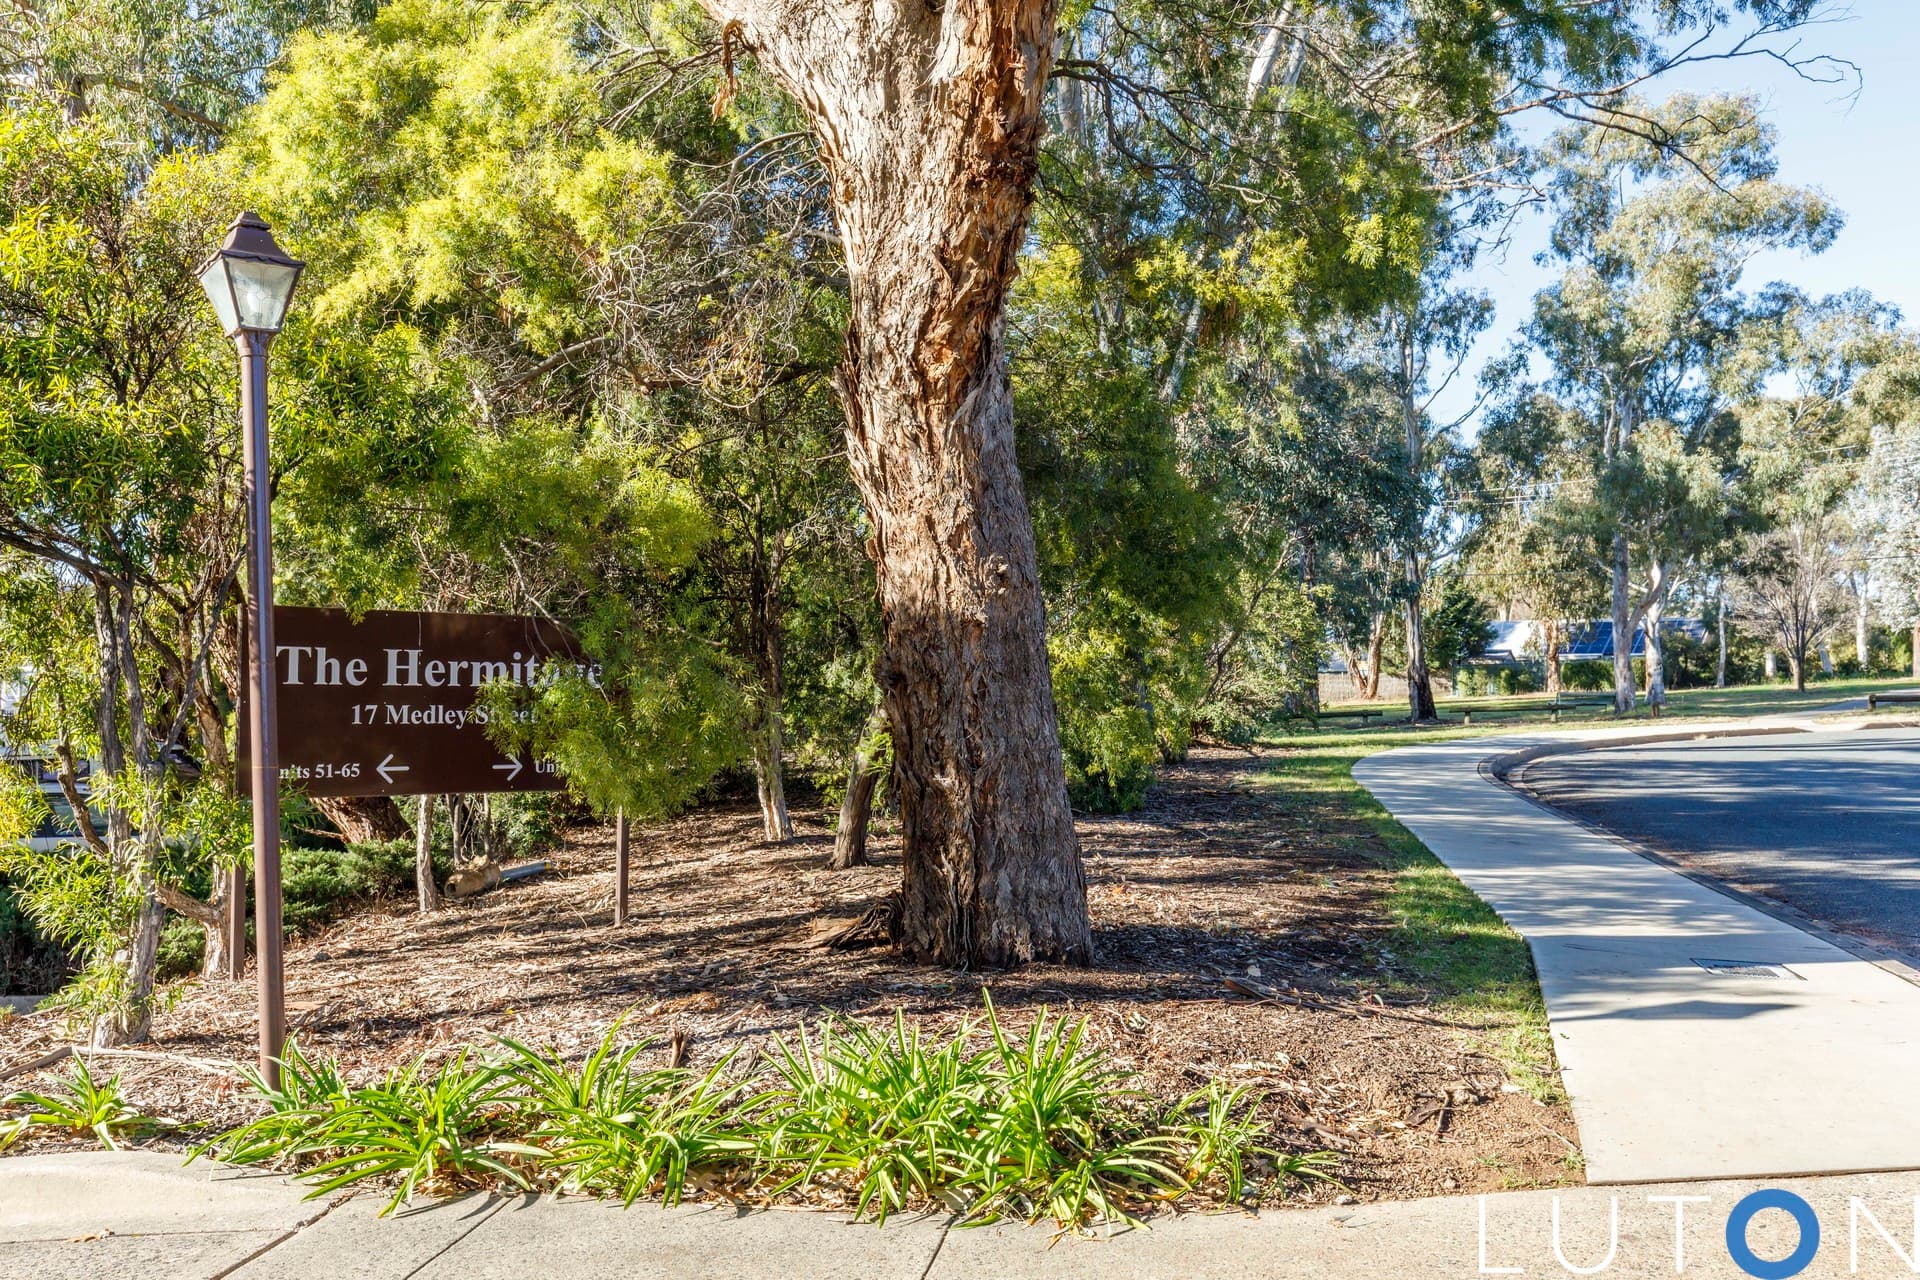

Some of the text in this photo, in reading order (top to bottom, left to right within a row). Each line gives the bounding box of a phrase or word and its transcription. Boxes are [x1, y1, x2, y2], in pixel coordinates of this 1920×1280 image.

[275, 645, 602, 689] The Hermite
[351, 704, 378, 725] 17
[385, 704, 468, 729] Medley
[315, 763, 360, 779] 51-65
